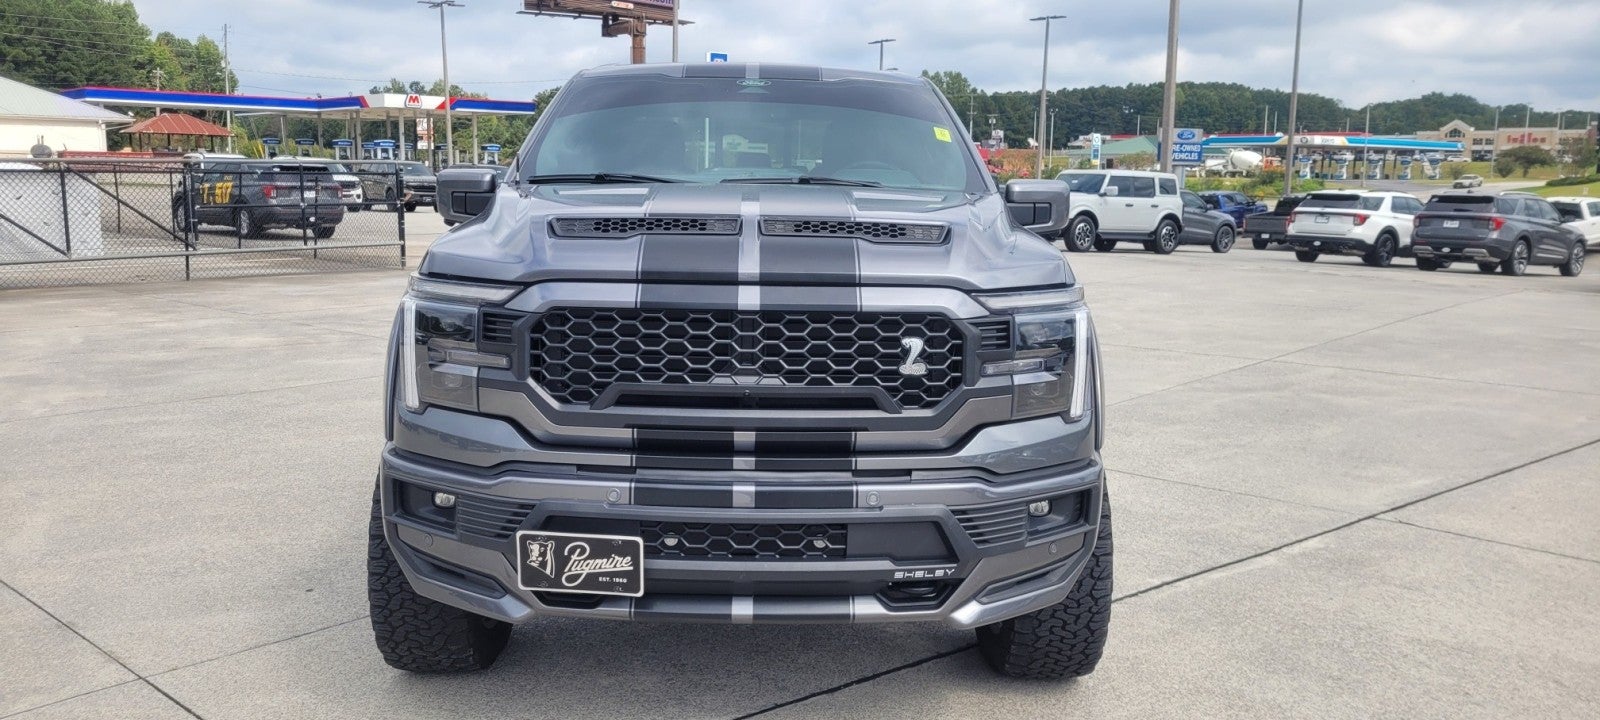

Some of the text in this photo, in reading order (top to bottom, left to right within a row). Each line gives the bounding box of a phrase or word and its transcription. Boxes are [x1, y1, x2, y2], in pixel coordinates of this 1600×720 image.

[408, 95, 420, 103] M
[1172, 144, 1201, 152] RE-OWNED
[562, 541, 634, 587] Pugmire
[894, 568, 955, 579] SHELBY
